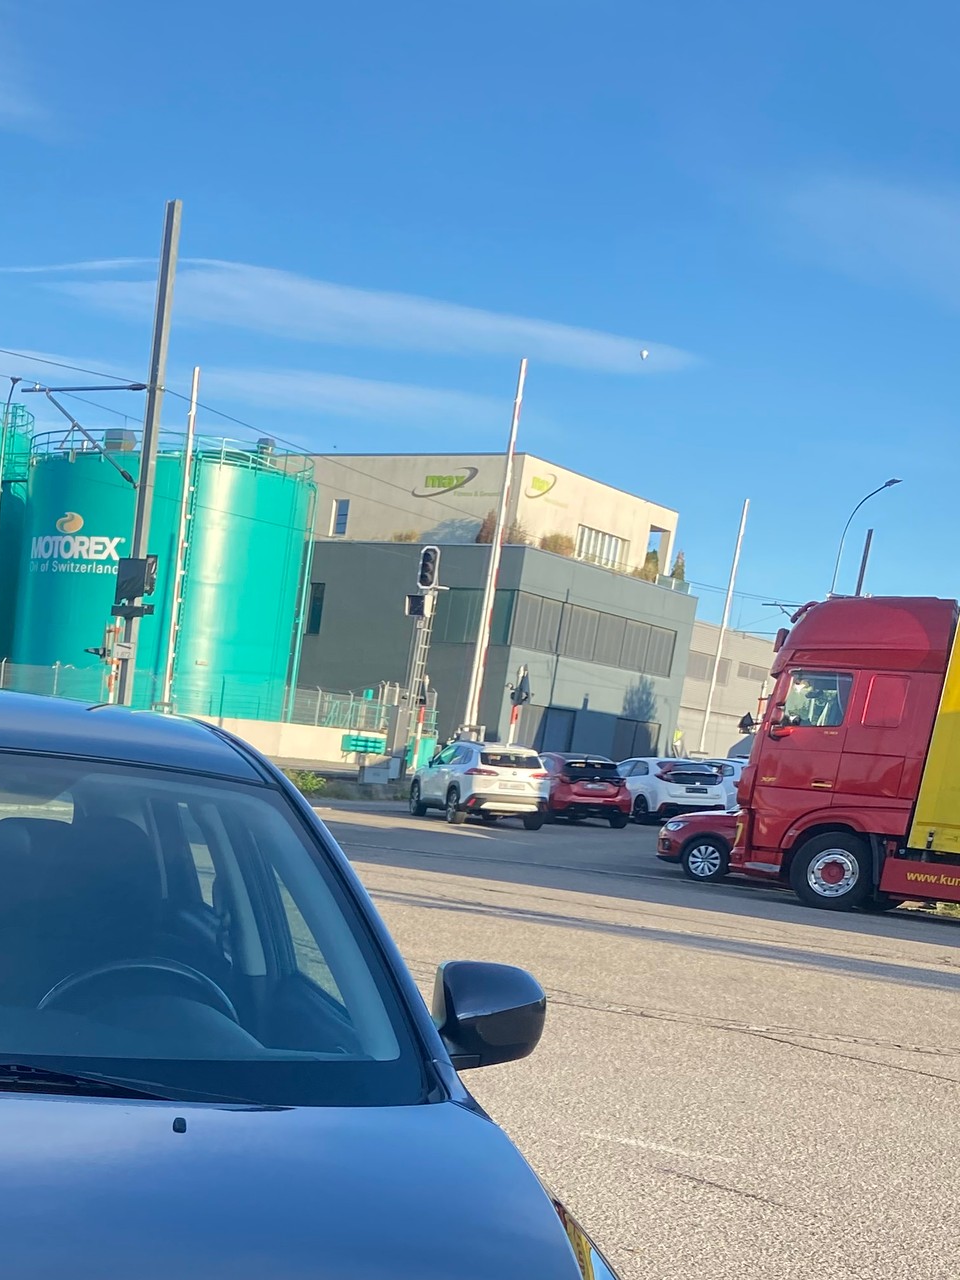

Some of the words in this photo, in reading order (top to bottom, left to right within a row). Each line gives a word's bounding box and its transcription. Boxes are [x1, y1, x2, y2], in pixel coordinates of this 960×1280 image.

[424, 475, 466, 488] max
[31, 536, 121, 560] MOTOREX
[40, 560, 49, 572] of
